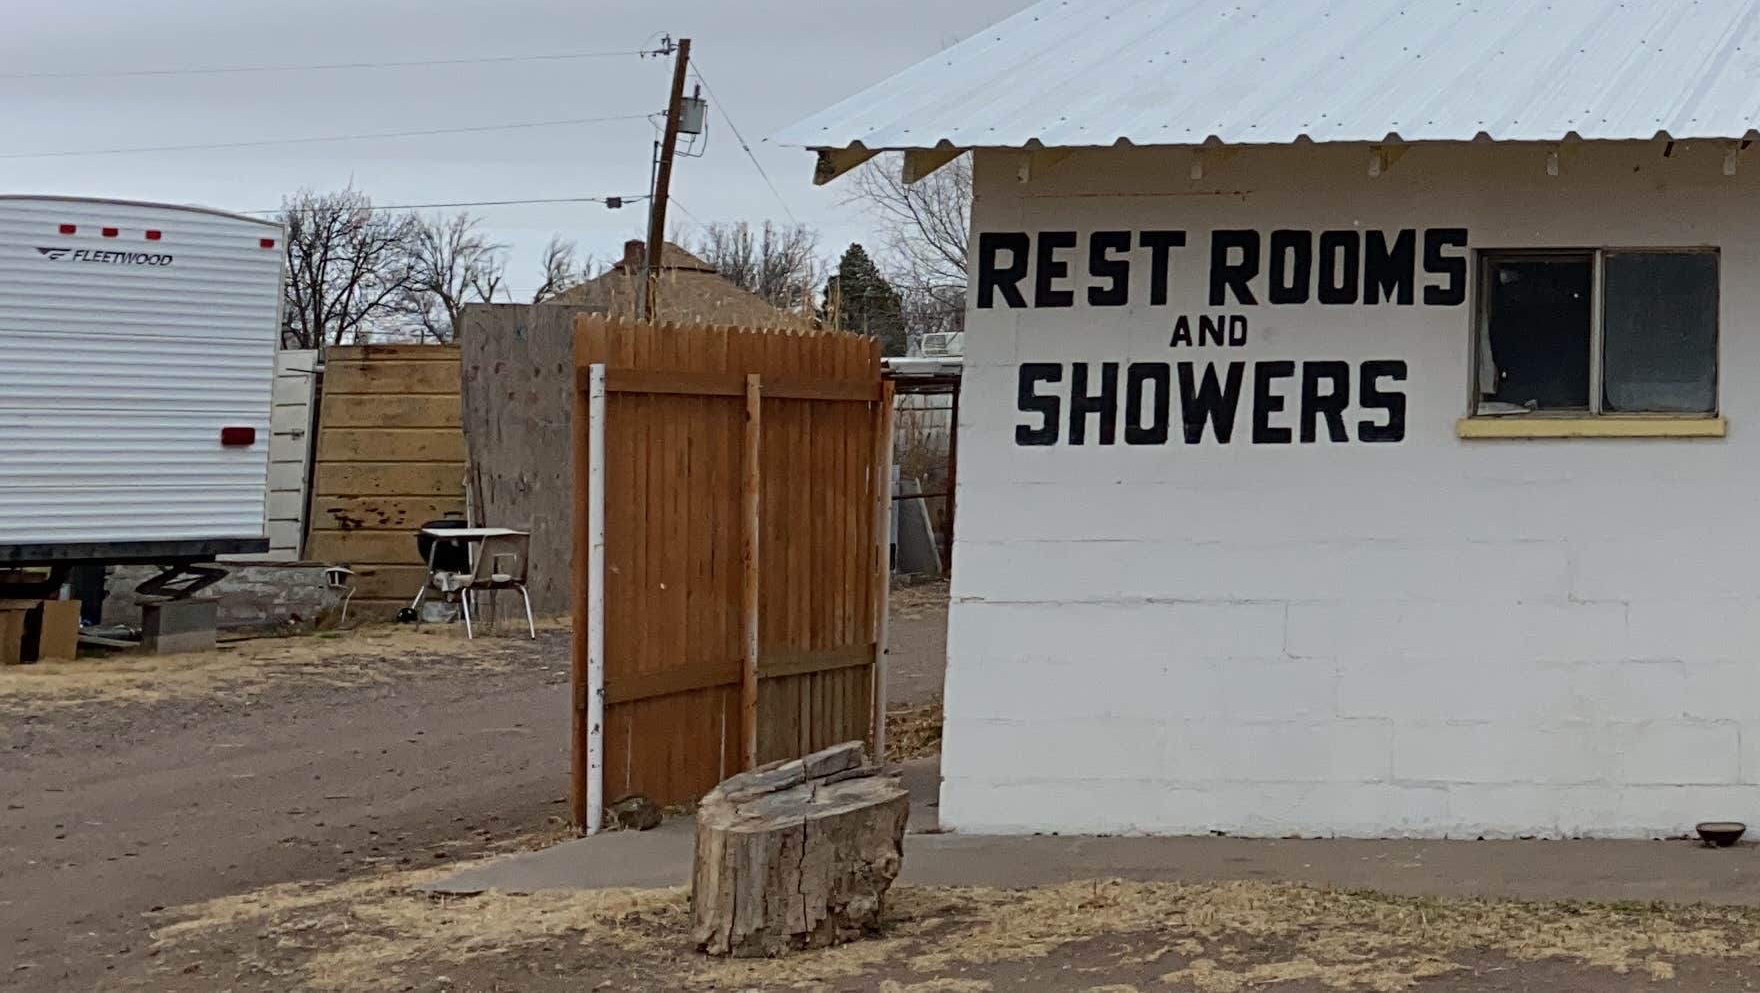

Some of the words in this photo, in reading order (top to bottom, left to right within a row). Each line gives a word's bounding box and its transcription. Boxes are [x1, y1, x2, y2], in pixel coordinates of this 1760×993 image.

[72, 249, 173, 267] FLEETWOOD
[977, 230, 1186, 309] REST
[1208, 227, 1468, 307] ROOMS
[1169, 314, 1248, 348] AND
[1014, 359, 1408, 447] SHOWERS
